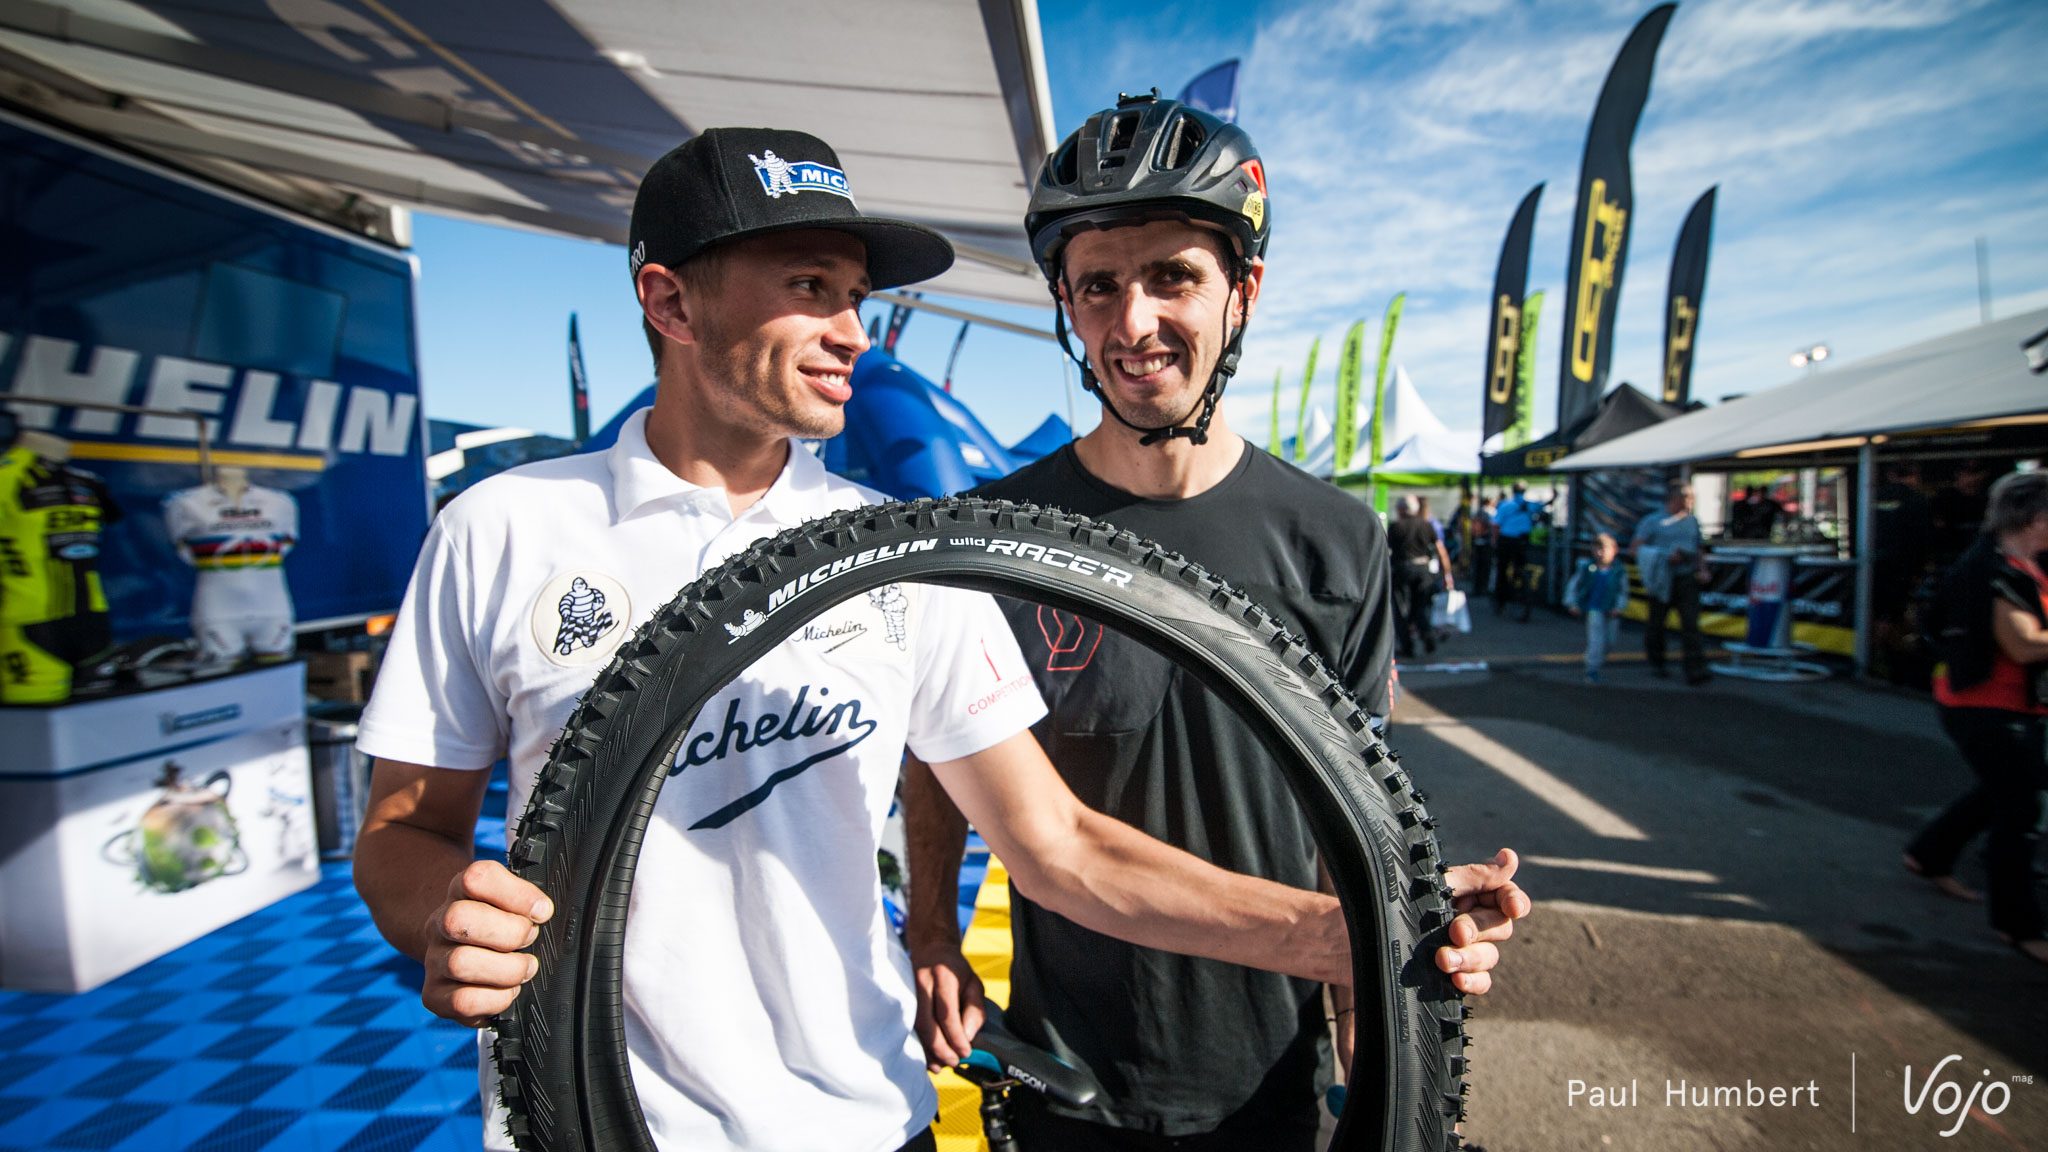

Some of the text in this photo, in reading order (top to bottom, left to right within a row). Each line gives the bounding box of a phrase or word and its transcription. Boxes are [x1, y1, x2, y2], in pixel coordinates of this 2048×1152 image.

[0, 331, 417, 457] HELIN
[768, 537, 1133, 613] MICHELIN wild RACE'R
[791, 620, 868, 647] Michelin
[1007, 1064, 1047, 1093] ERGON
